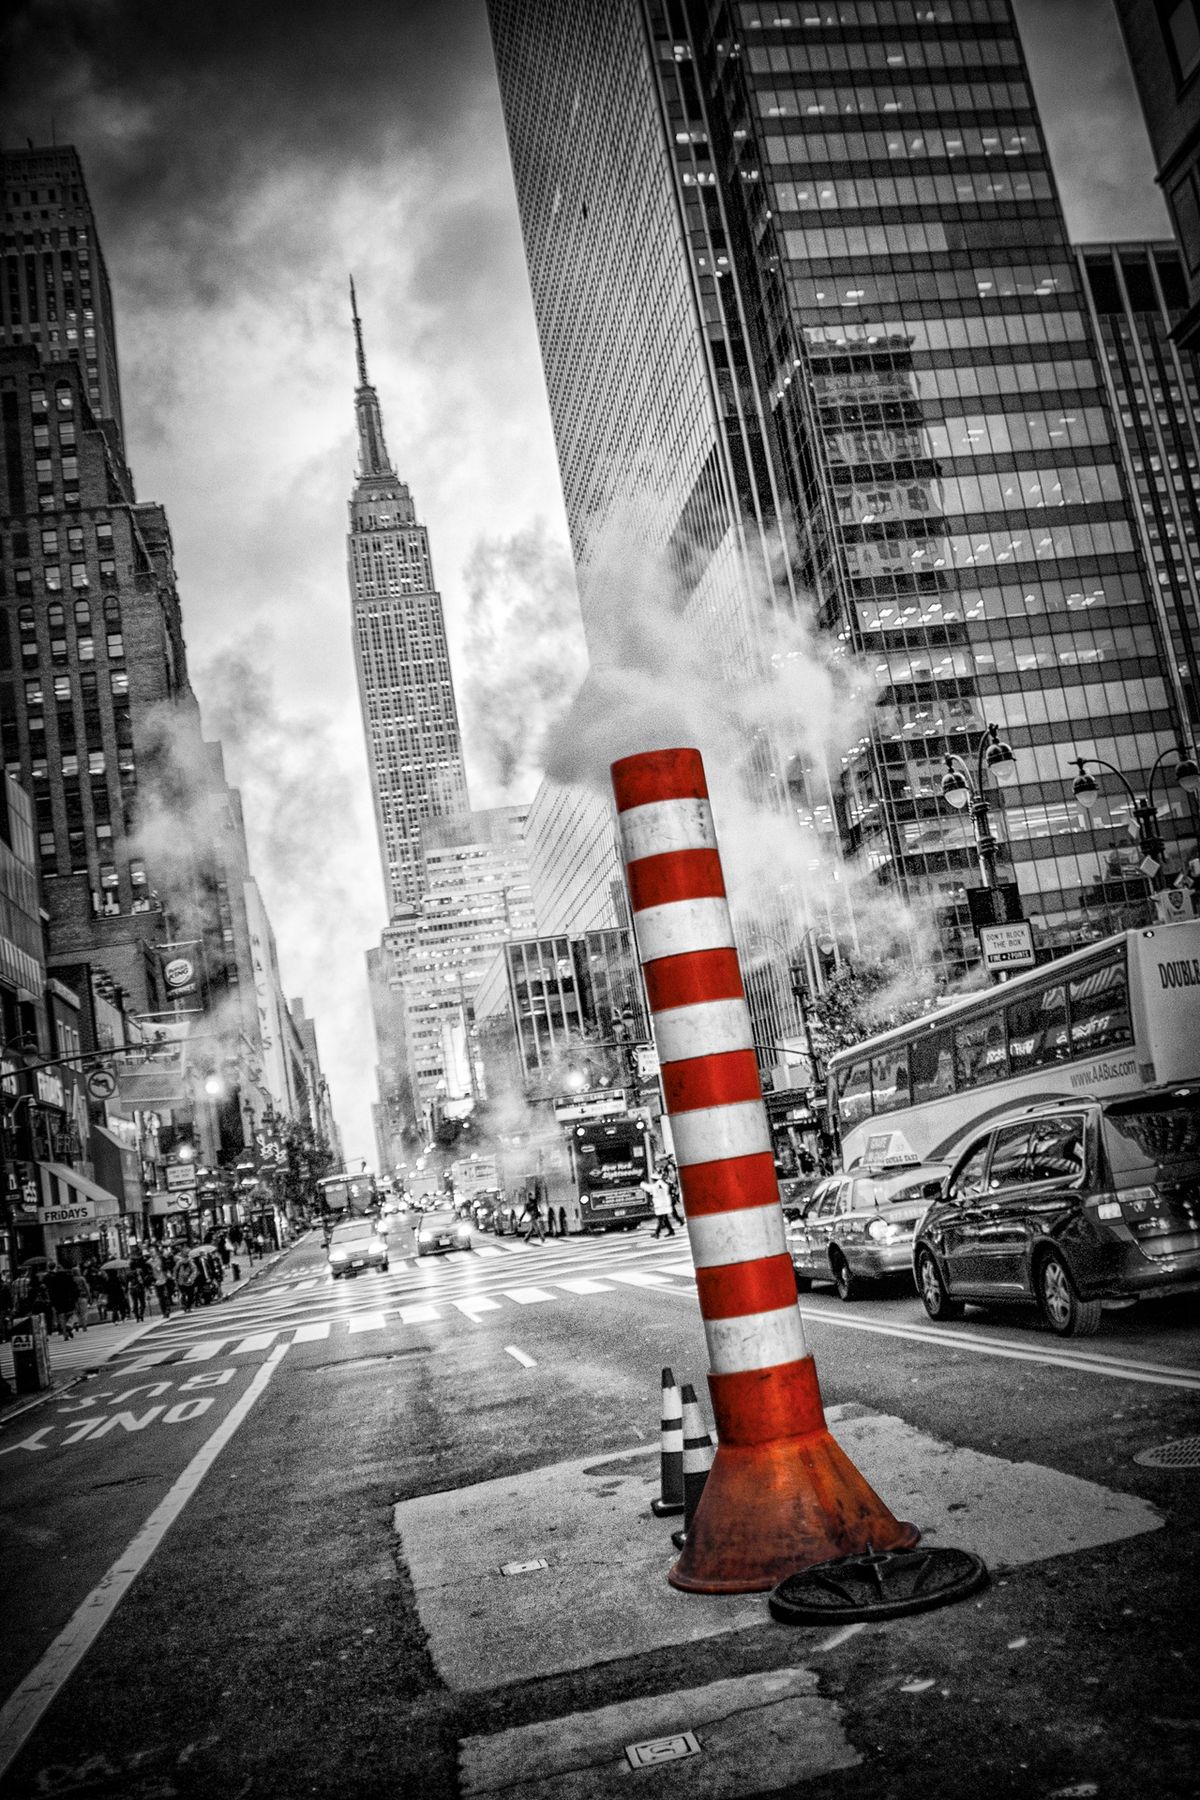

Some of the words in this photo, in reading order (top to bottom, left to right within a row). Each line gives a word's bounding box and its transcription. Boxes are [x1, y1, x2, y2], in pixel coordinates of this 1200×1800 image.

[986, 932, 1003, 942] DON'T
[1006, 930, 1026, 938] BLOCK
[993, 940, 1006, 949] THE
[1008, 939, 1022, 947] BOX
[169, 967, 190, 979] KING
[1157, 959, 1200, 989] DOUBLE
[1070, 1060, 1137, 1088] www.AABus.com
[56, 1368, 238, 1413] BUS
[0, 1398, 216, 1455] ONLY
